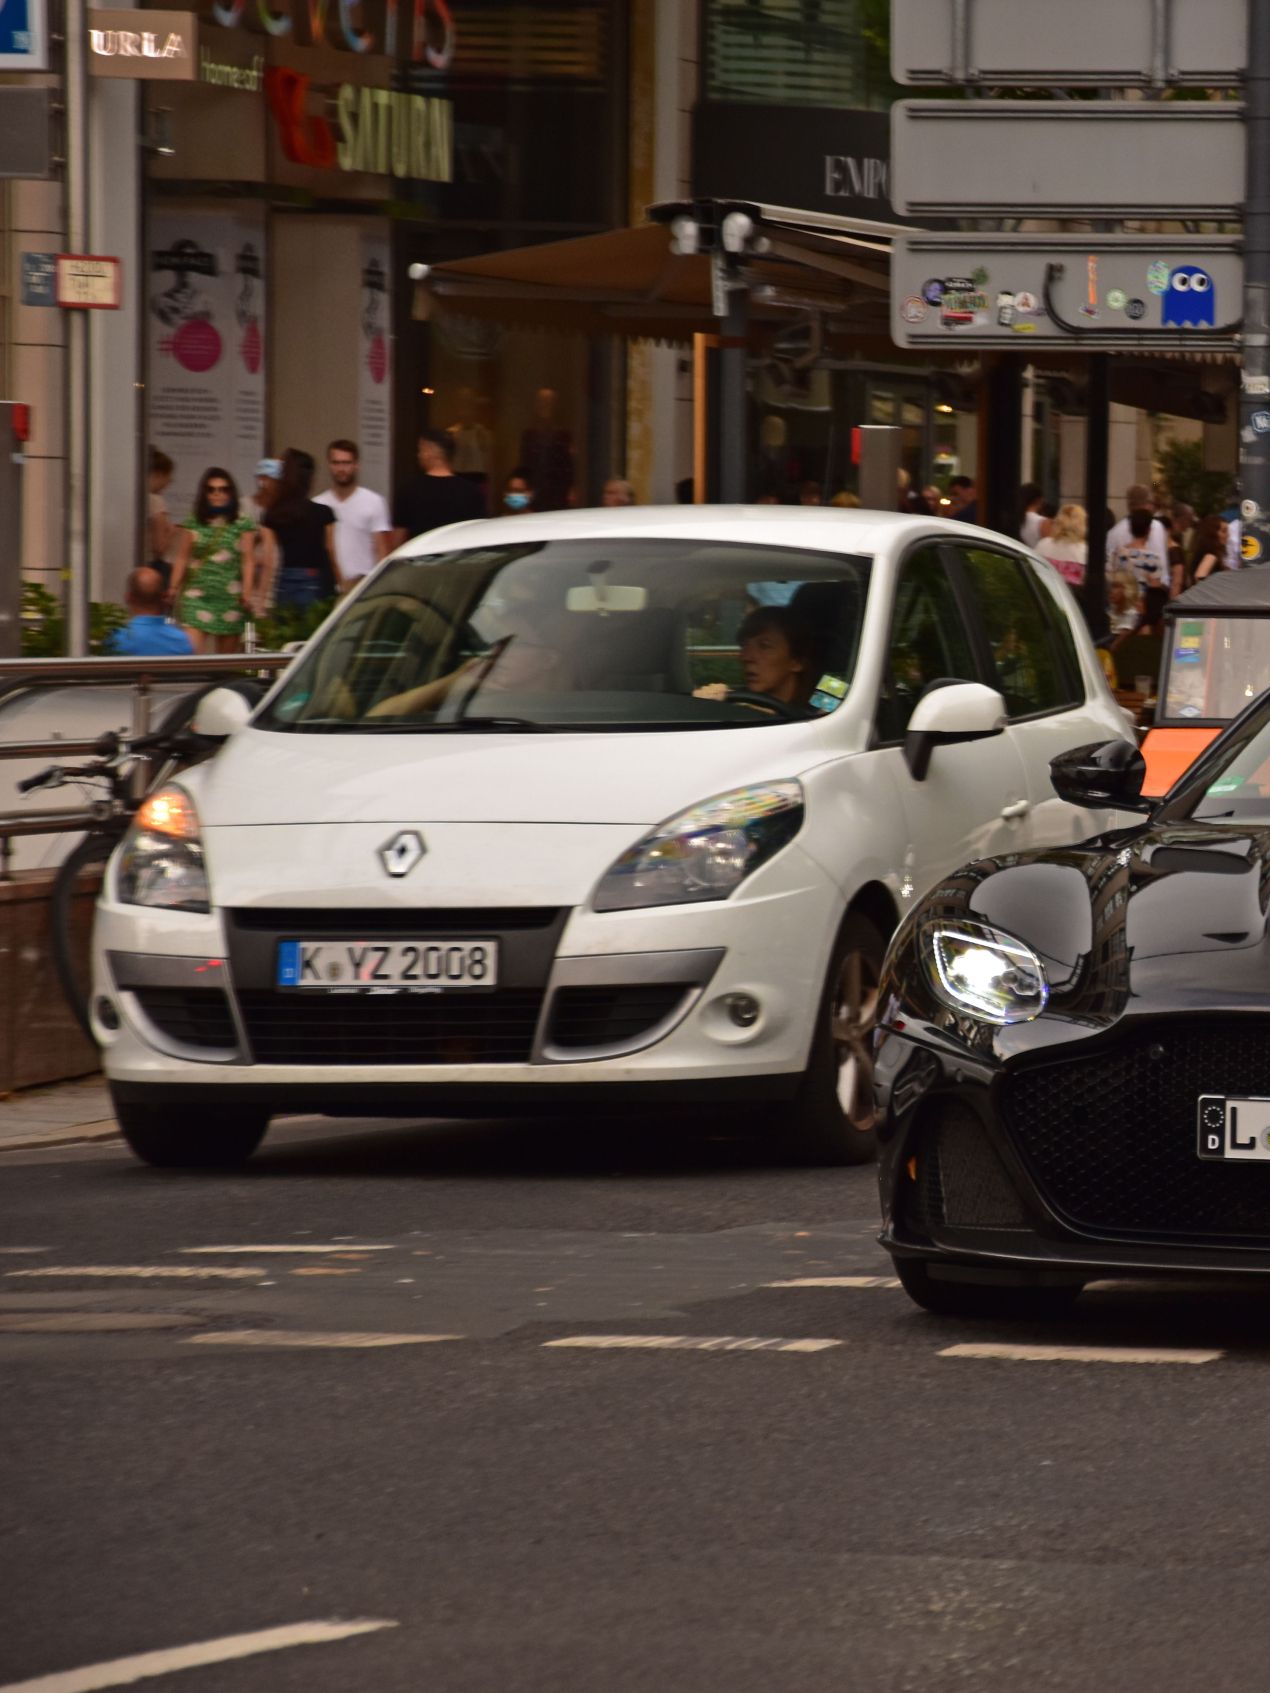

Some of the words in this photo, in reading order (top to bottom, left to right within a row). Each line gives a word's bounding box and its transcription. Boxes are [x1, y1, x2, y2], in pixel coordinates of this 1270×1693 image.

[88, 29, 188, 58] URLA
[334, 82, 454, 182] SATURN
[823, 155, 890, 199] EMP
[301, 946, 321, 980] K
[347, 946, 391, 980] YZ
[400, 946, 488, 980] 2008
[1207, 1134, 1219, 1150] D
[1230, 1106, 1256, 1150] L
